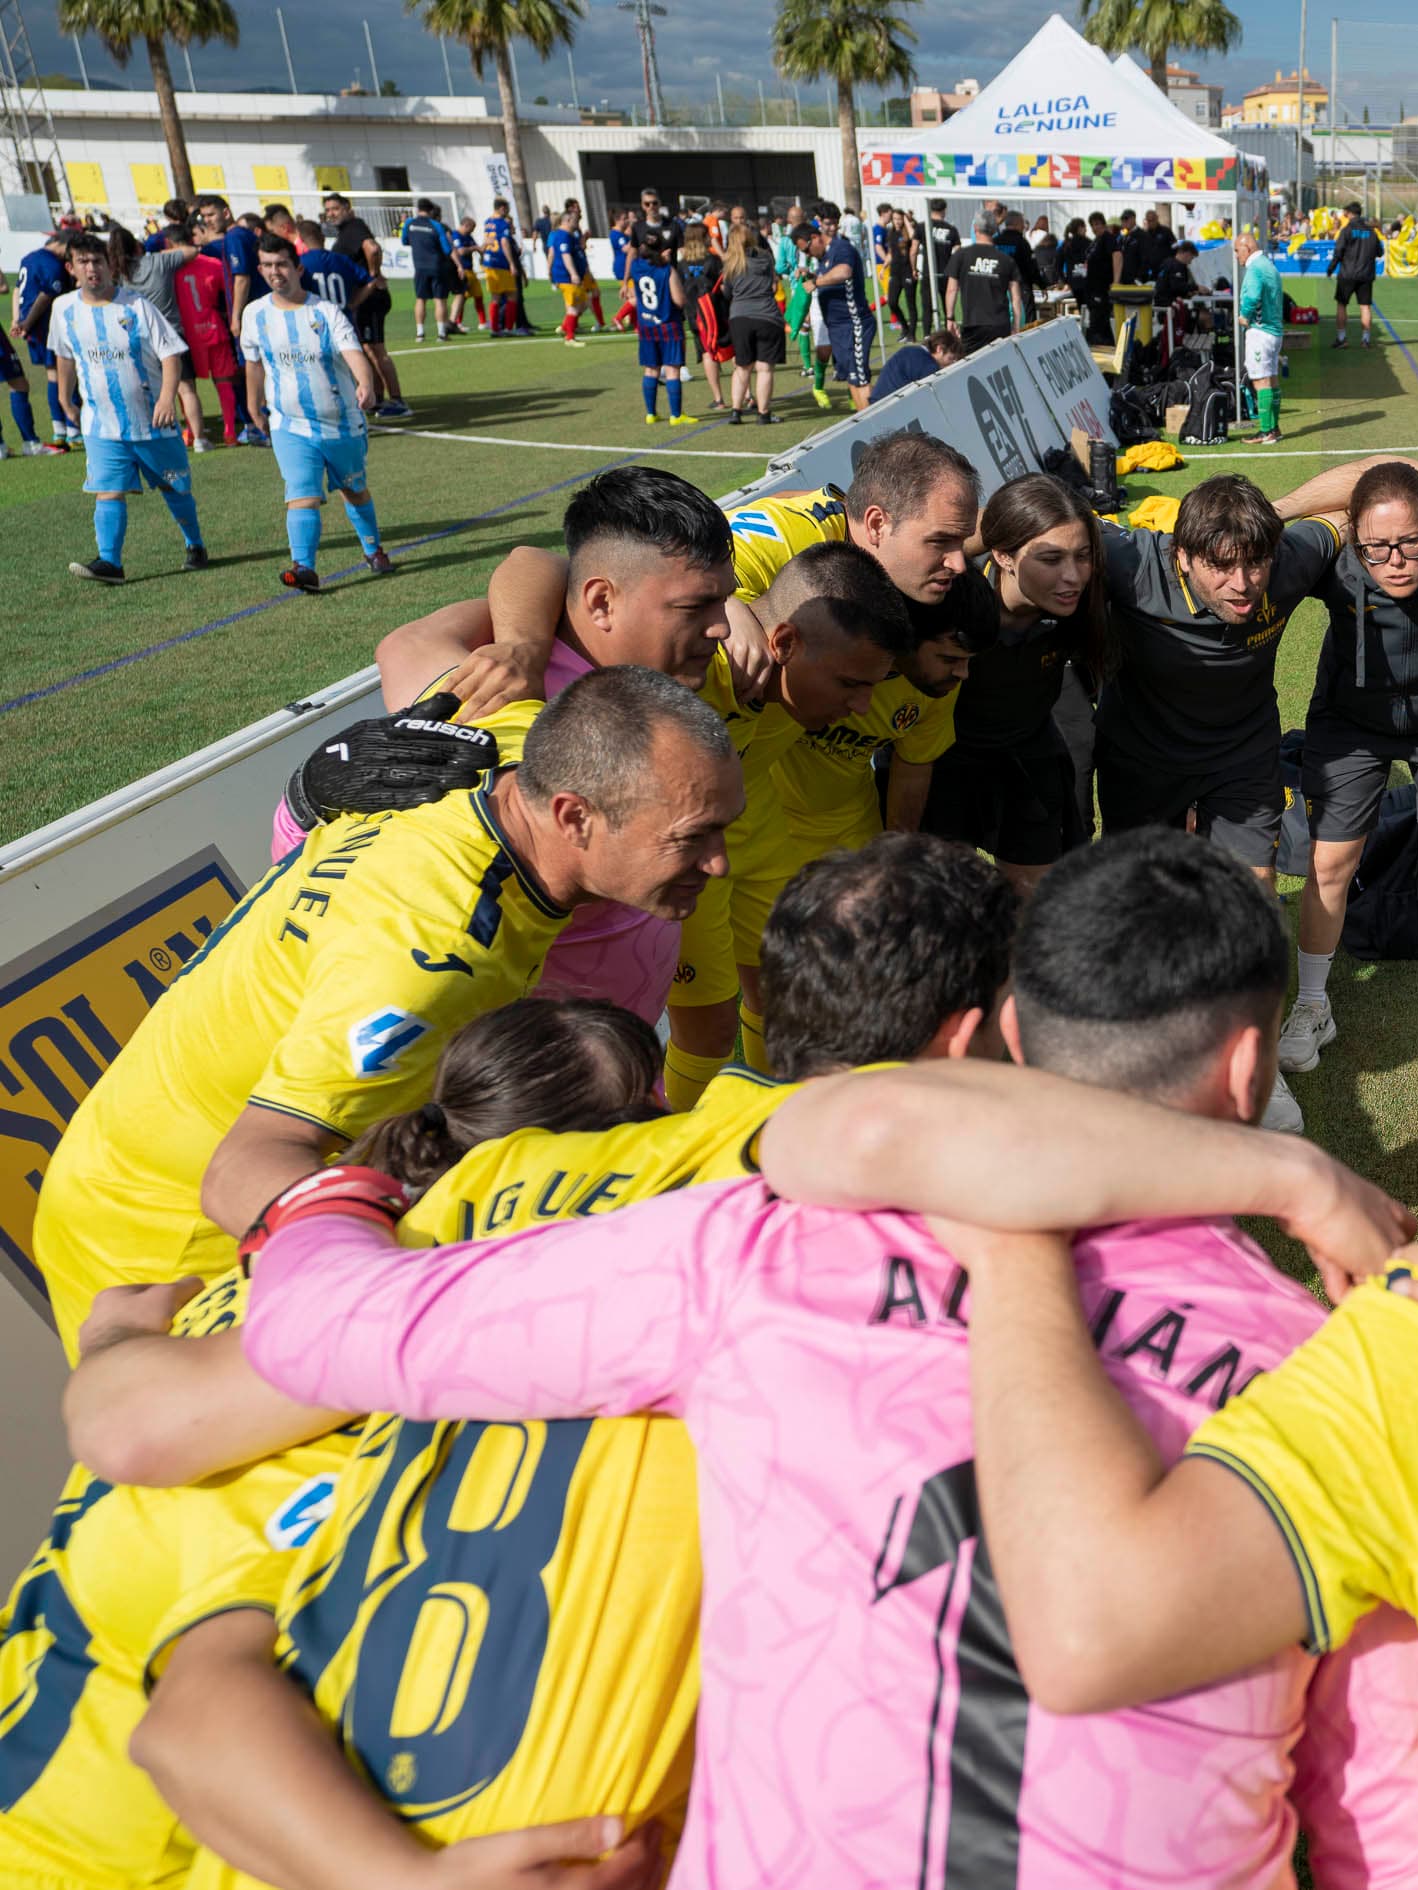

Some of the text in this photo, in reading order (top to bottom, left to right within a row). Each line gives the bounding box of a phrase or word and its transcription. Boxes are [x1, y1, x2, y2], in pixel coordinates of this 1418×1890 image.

[998, 95, 1089, 119] LALIGA
[994, 112, 1117, 134] GENUINE
[312, 272, 347, 310] 10
[639, 276, 658, 310] 8
[1037, 330, 1094, 398] FUNDACIÓN
[394, 718, 491, 746] reusch
